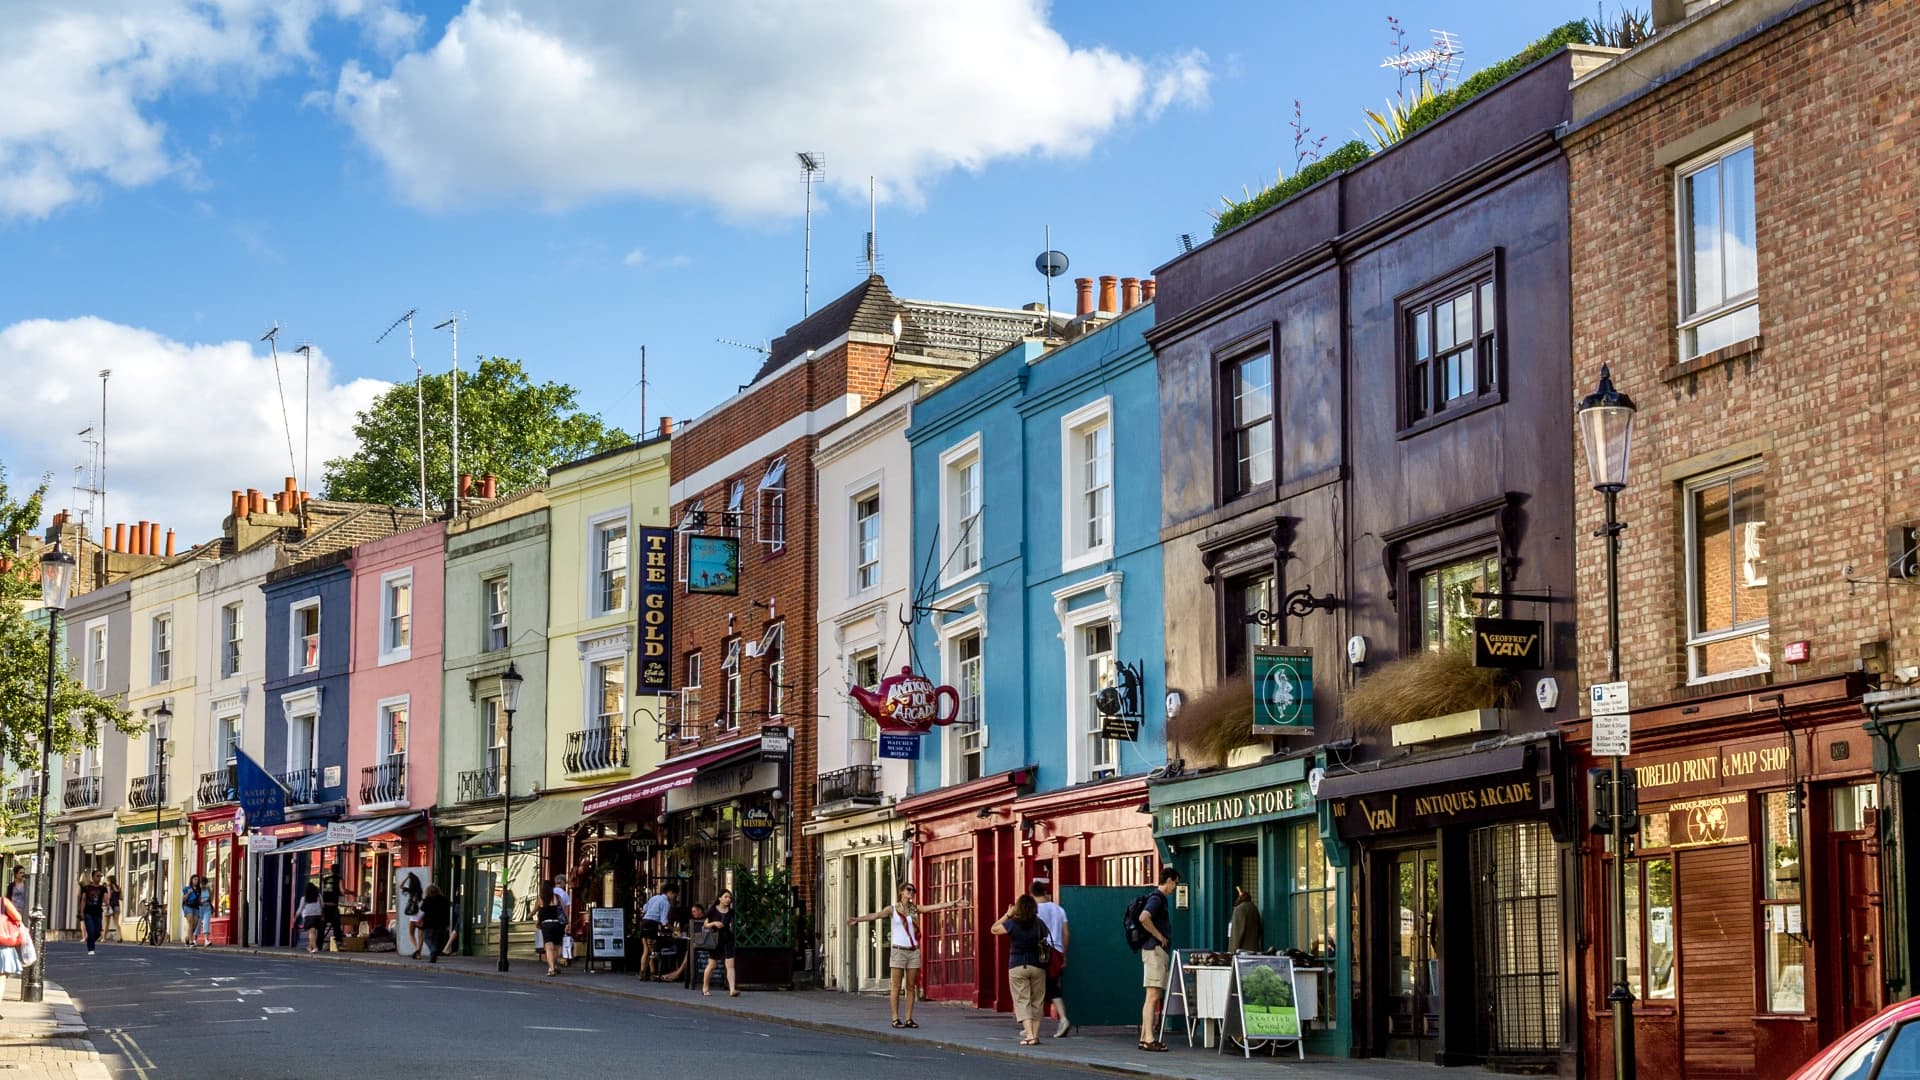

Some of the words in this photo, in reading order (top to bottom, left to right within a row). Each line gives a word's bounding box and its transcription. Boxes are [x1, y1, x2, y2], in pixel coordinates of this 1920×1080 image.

[646, 536, 666, 583] THE
[645, 594, 665, 657] GOLD
[1480, 632, 1538, 657] VAN
[1489, 634, 1528, 643] GEOFFREY
[893, 703, 936, 720] ARCADE
[911, 692, 927, 707] 101
[1635, 762, 1680, 789] TOBELLO
[1683, 756, 1718, 783] PRINT
[1722, 758, 1730, 777] &
[1731, 750, 1757, 777] MAP
[1760, 746, 1790, 773] SHOP
[1172, 797, 1243, 828] HIGHLAND
[1248, 788, 1294, 816] STORE
[1332, 803, 1346, 817] 107
[1359, 794, 1398, 831] VAN
[1415, 790, 1477, 817] ANTIQUES
[1480, 782, 1534, 807] ARCADE
[1669, 800, 1698, 812] ANTIQUE
[1698, 797, 1721, 808] PRINTS
[1728, 794, 1747, 804] MAPS
